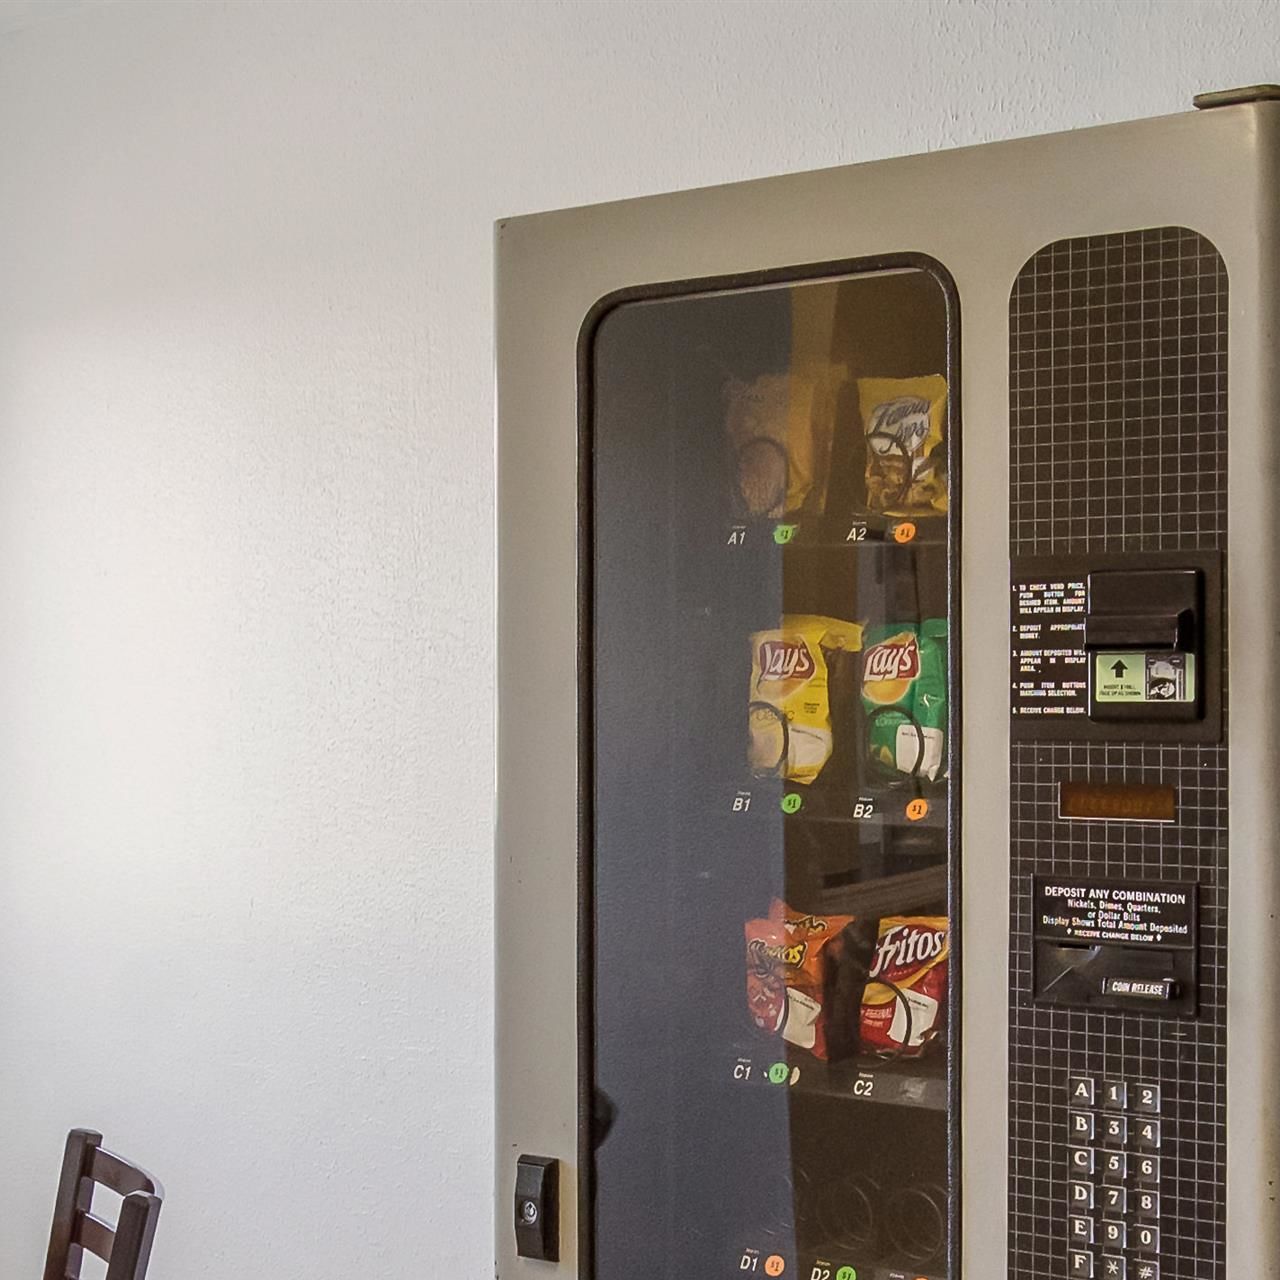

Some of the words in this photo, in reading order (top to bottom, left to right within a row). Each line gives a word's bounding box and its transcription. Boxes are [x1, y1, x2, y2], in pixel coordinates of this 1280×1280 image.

[728, 532, 746, 545] A1
[847, 528, 867, 541] A2
[761, 641, 810, 681] Lay's
[864, 640, 914, 681] Lay's
[732, 798, 751, 812] B1
[853, 804, 874, 819] B2
[1044, 886, 1087, 898] DEPOSIT
[1088, 888, 1110, 900] ANY
[1112, 890, 1187, 905] COMBINATION
[1067, 898, 1097, 910] Nickels,
[1099, 900, 1125, 912] Dimes,
[1126, 902, 1161, 914] Quarters,
[1087, 911, 1096, 919] or
[1098, 910, 1121, 920] Dollar
[1123, 911, 1141, 922] Bills
[1042, 915, 1070, 927] Display
[1071, 917, 1095, 927] Shows
[1097, 918, 1116, 929] Total
[1117, 920, 1147, 931] Amount
[1149, 922, 1188, 934] Deposited
[869, 925, 945, 978] Fritos
[1112, 981, 1131, 993] COIN
[1131, 982, 1164, 996] RELEASE
[733, 1065, 752, 1080] C1
[853, 1080, 874, 1096] C2
[1074, 1082, 1089, 1097] A
[1109, 1086, 1118, 1100] 1
[1142, 1089, 1153, 1104] 2
[1075, 1117, 1088, 1131] B
[1108, 1121, 1119, 1135] 3
[1142, 1124, 1152, 1140] 4
[1074, 1151, 1088, 1166] C
[1108, 1156, 1119, 1170] 5
[1141, 1160, 1152, 1175] 6
[1074, 1185, 1088, 1200] D
[1108, 1190, 1119, 1205] 7
[1141, 1195, 1152, 1210] 8
[1074, 1220, 1087, 1235] E
[1107, 1225, 1118, 1239] 9
[1140, 1230, 1151, 1245] 0
[739, 1255, 758, 1271] D1
[1073, 1254, 1087, 1269] F
